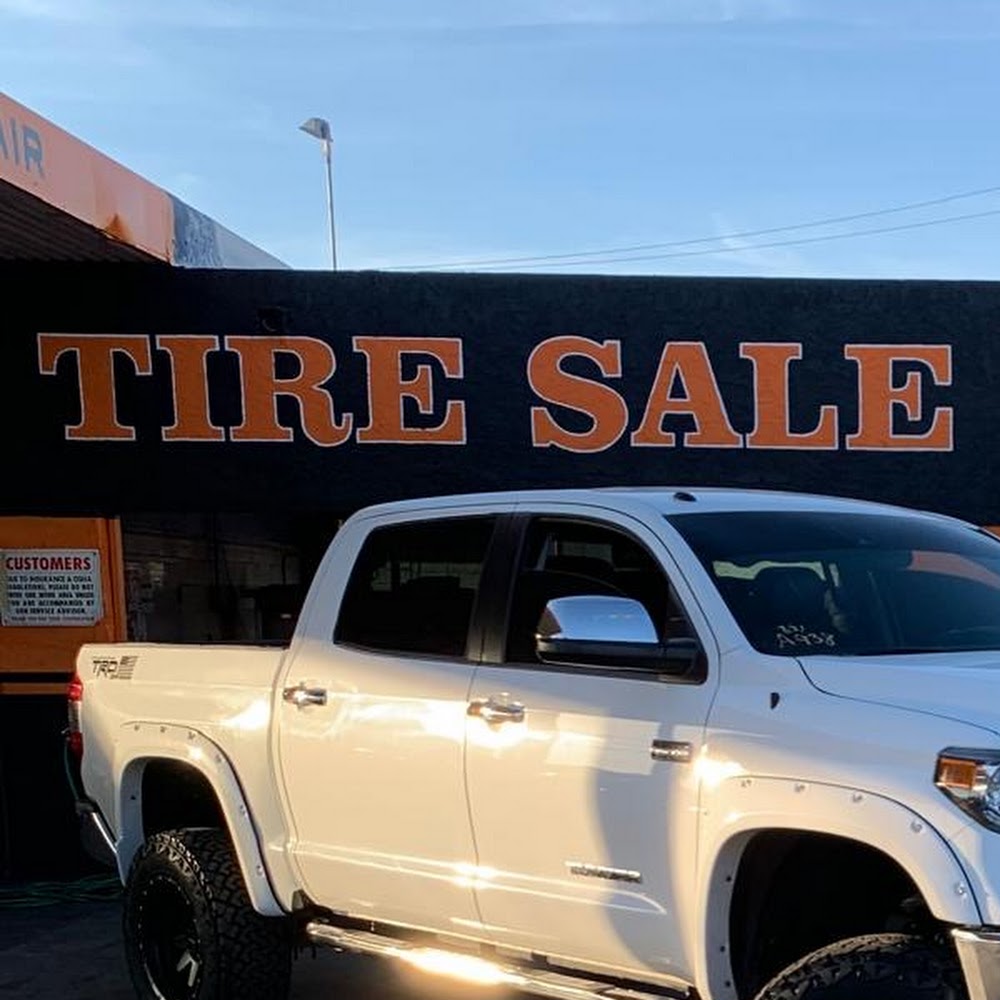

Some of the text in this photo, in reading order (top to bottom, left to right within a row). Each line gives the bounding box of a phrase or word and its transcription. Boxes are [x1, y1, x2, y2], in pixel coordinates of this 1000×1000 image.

[37, 333, 955, 453] TIRE SALE
[5, 556, 91, 571] CUSTOMERS
